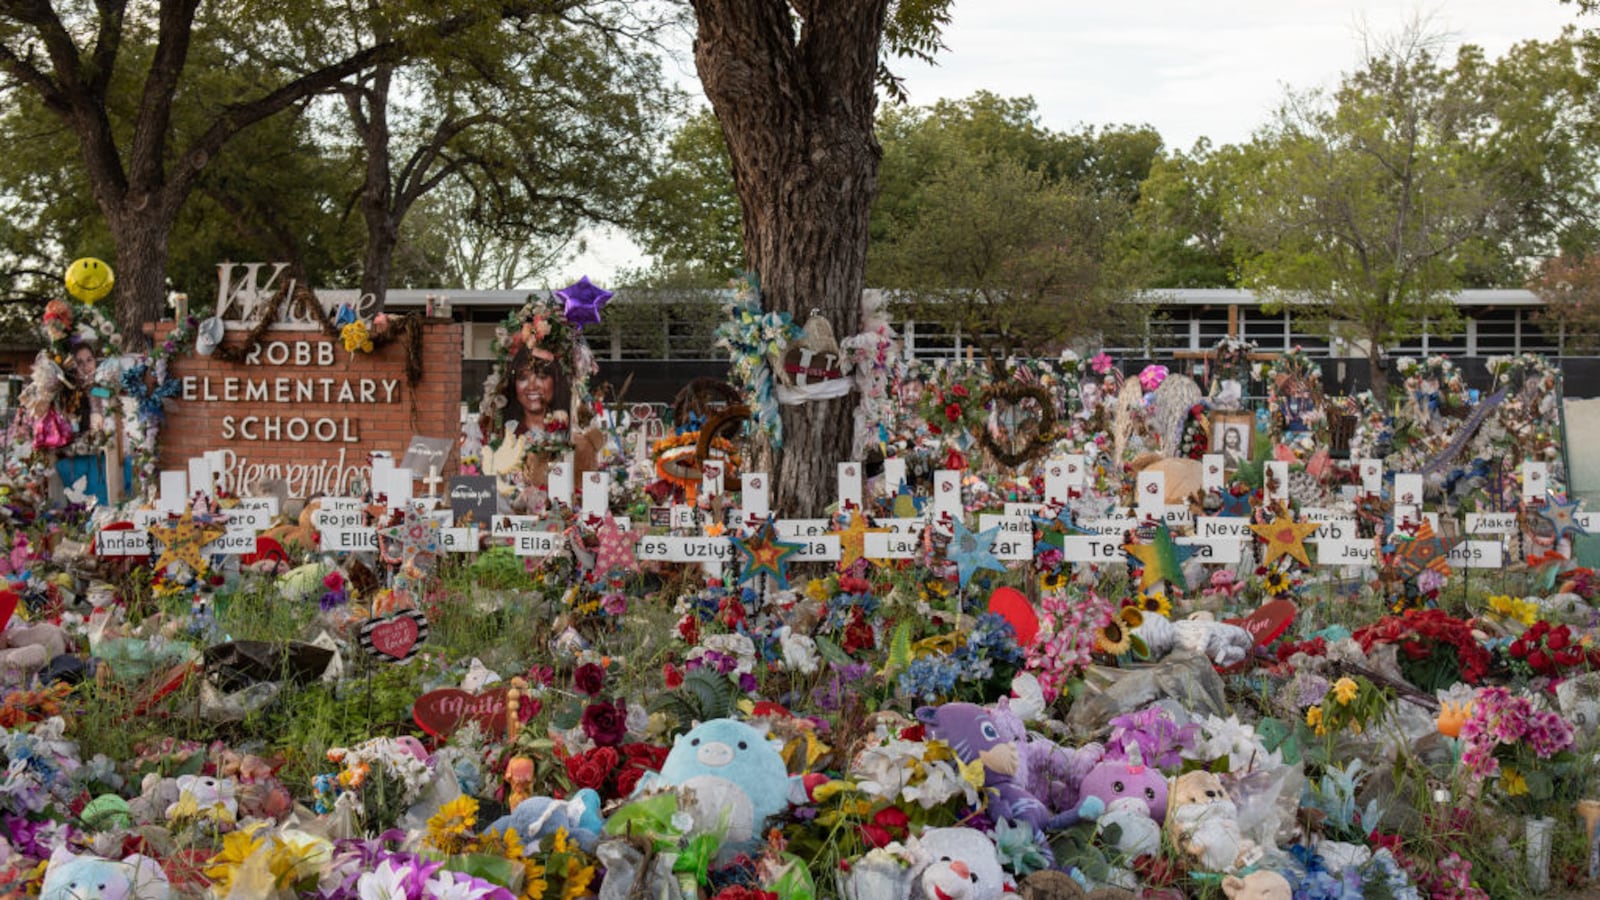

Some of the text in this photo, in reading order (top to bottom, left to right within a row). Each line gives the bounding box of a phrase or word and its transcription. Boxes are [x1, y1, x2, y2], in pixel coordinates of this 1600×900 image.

[245, 341, 335, 366] ROBB
[182, 376, 398, 404] ELEMENTARY
[221, 415, 359, 442] SCHOOL
[341, 532, 379, 547] Ellie
[989, 542, 1021, 555] zar
